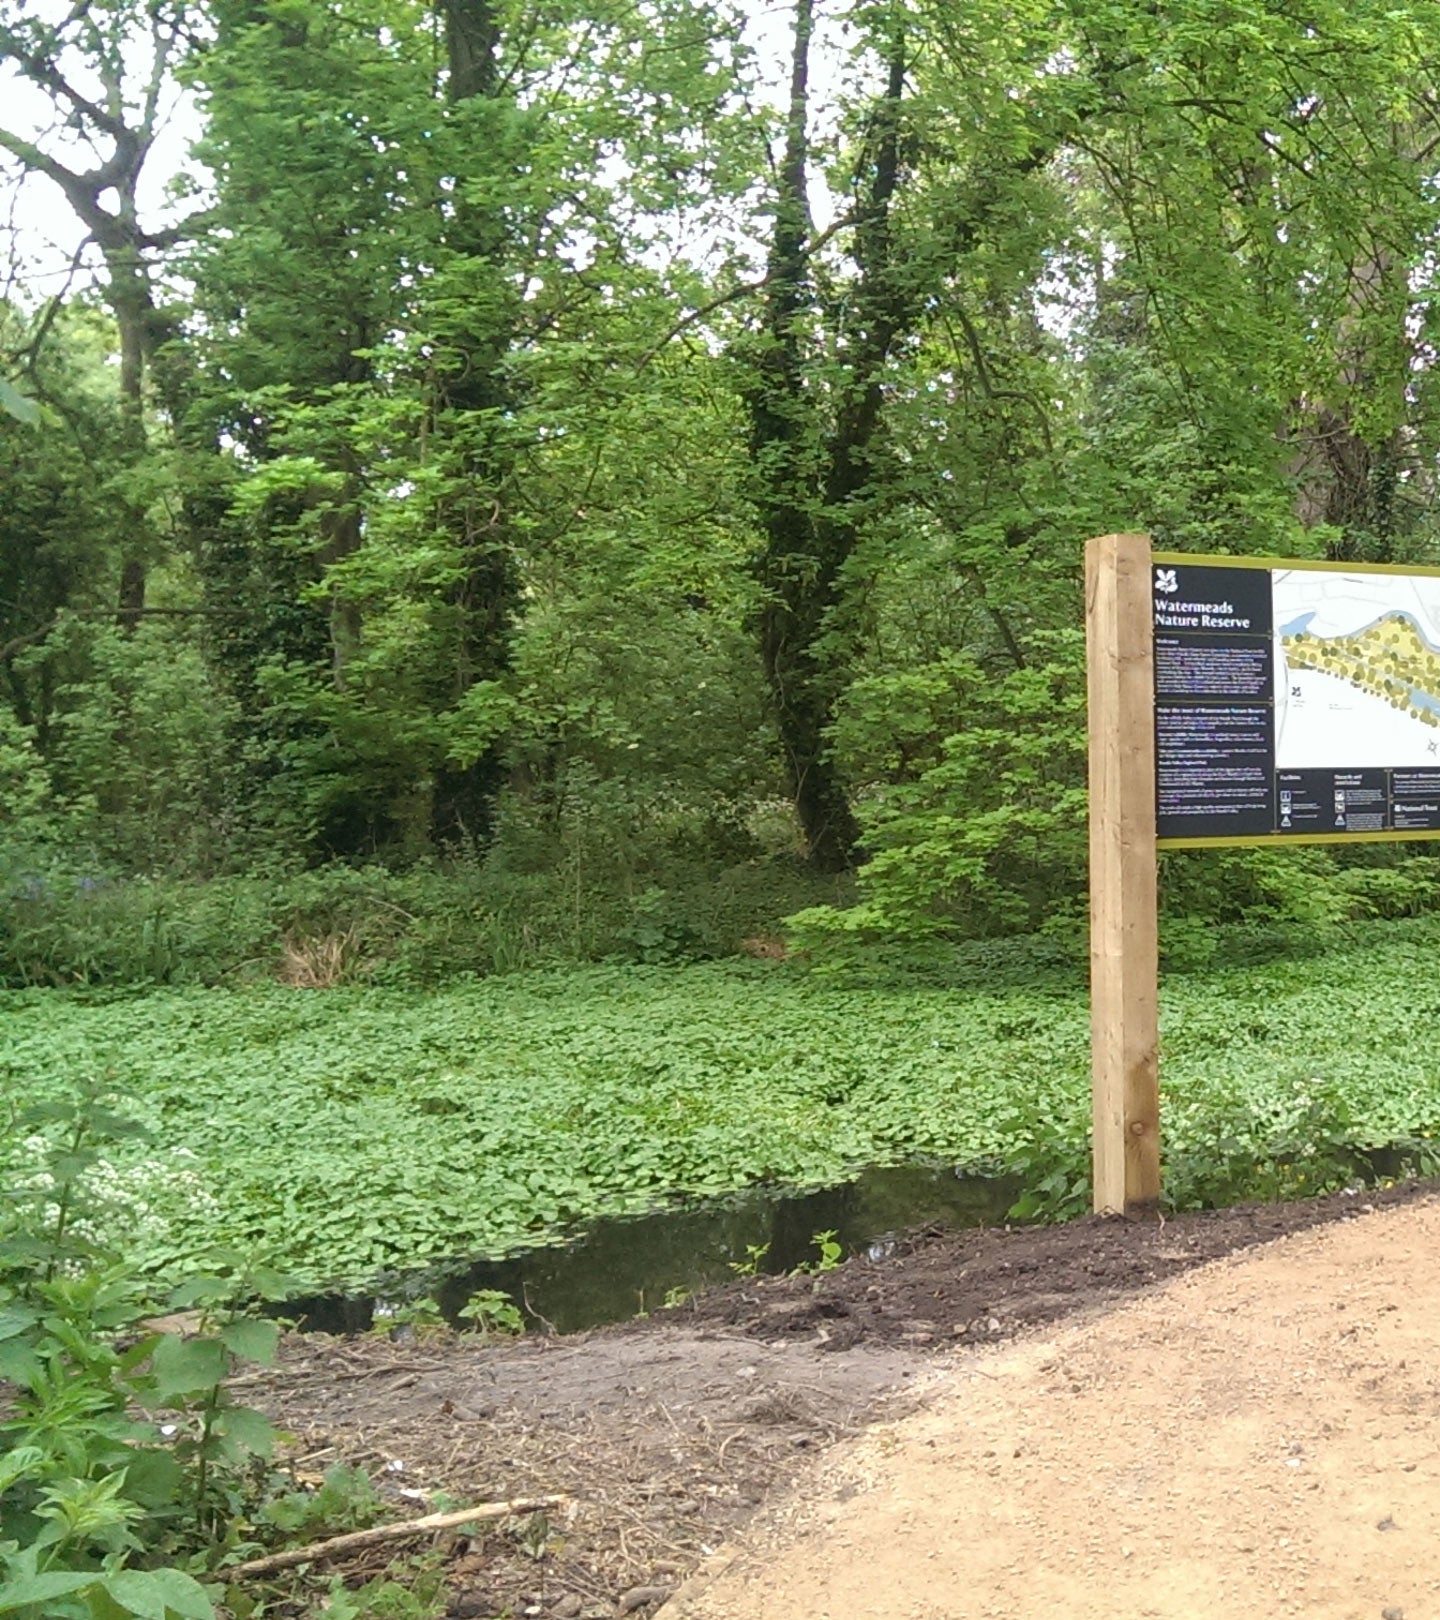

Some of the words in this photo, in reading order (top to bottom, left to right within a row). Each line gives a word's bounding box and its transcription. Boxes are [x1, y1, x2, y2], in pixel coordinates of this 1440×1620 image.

[1154, 599, 1233, 614] Watermeads
[1155, 614, 1198, 627] Nature
[1201, 615, 1250, 628] Reserve
